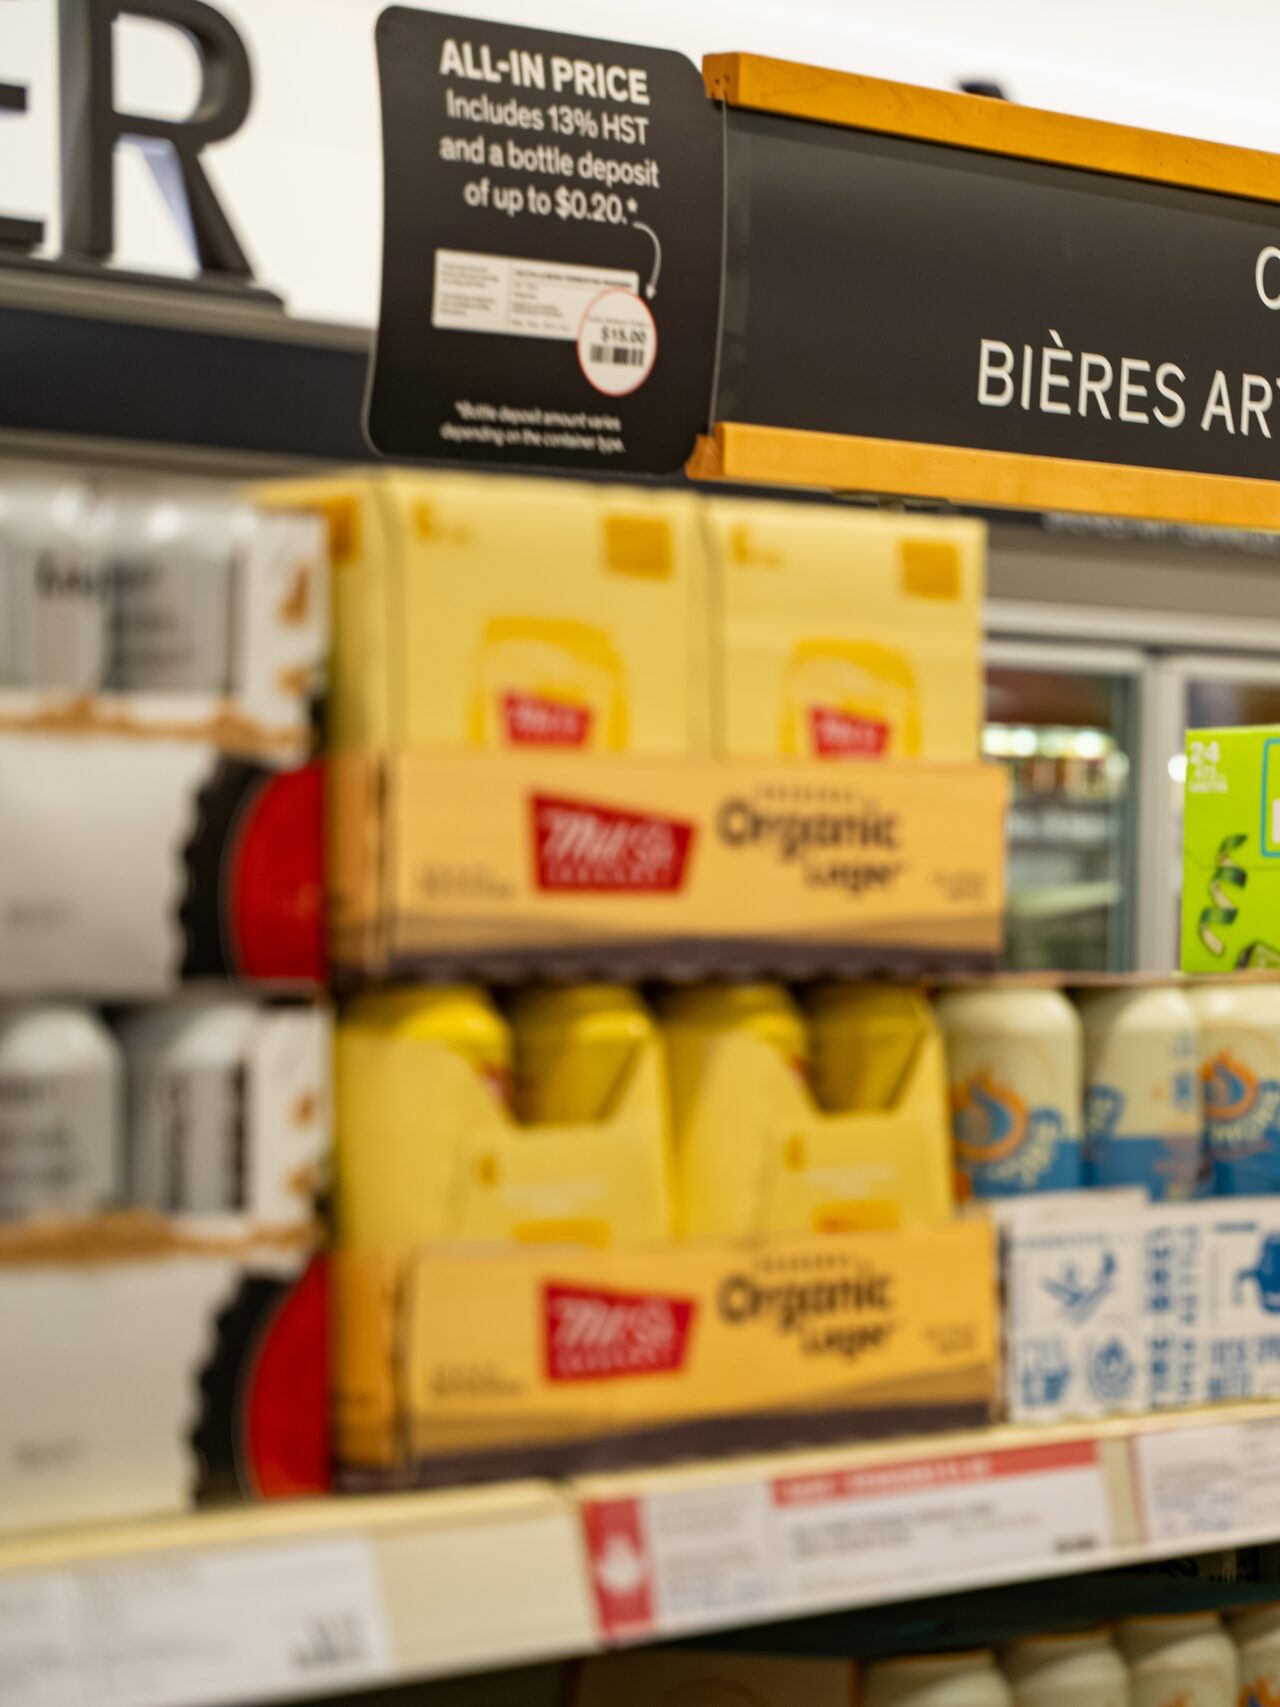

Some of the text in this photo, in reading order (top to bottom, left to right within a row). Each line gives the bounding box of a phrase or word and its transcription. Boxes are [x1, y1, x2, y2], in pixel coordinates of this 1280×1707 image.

[440, 38, 650, 105] ALL-IN PRICE
[446, 88, 649, 145] Includes 13% HST
[440, 135, 660, 188] and a bottle deposit
[463, 176, 491, 206] of
[492, 186, 524, 218] up
[527, 185, 552, 216] to
[978, 328, 1187, 429] BIÈRES
[716, 797, 899, 863] Organic
[716, 1272, 891, 1336] Organic
